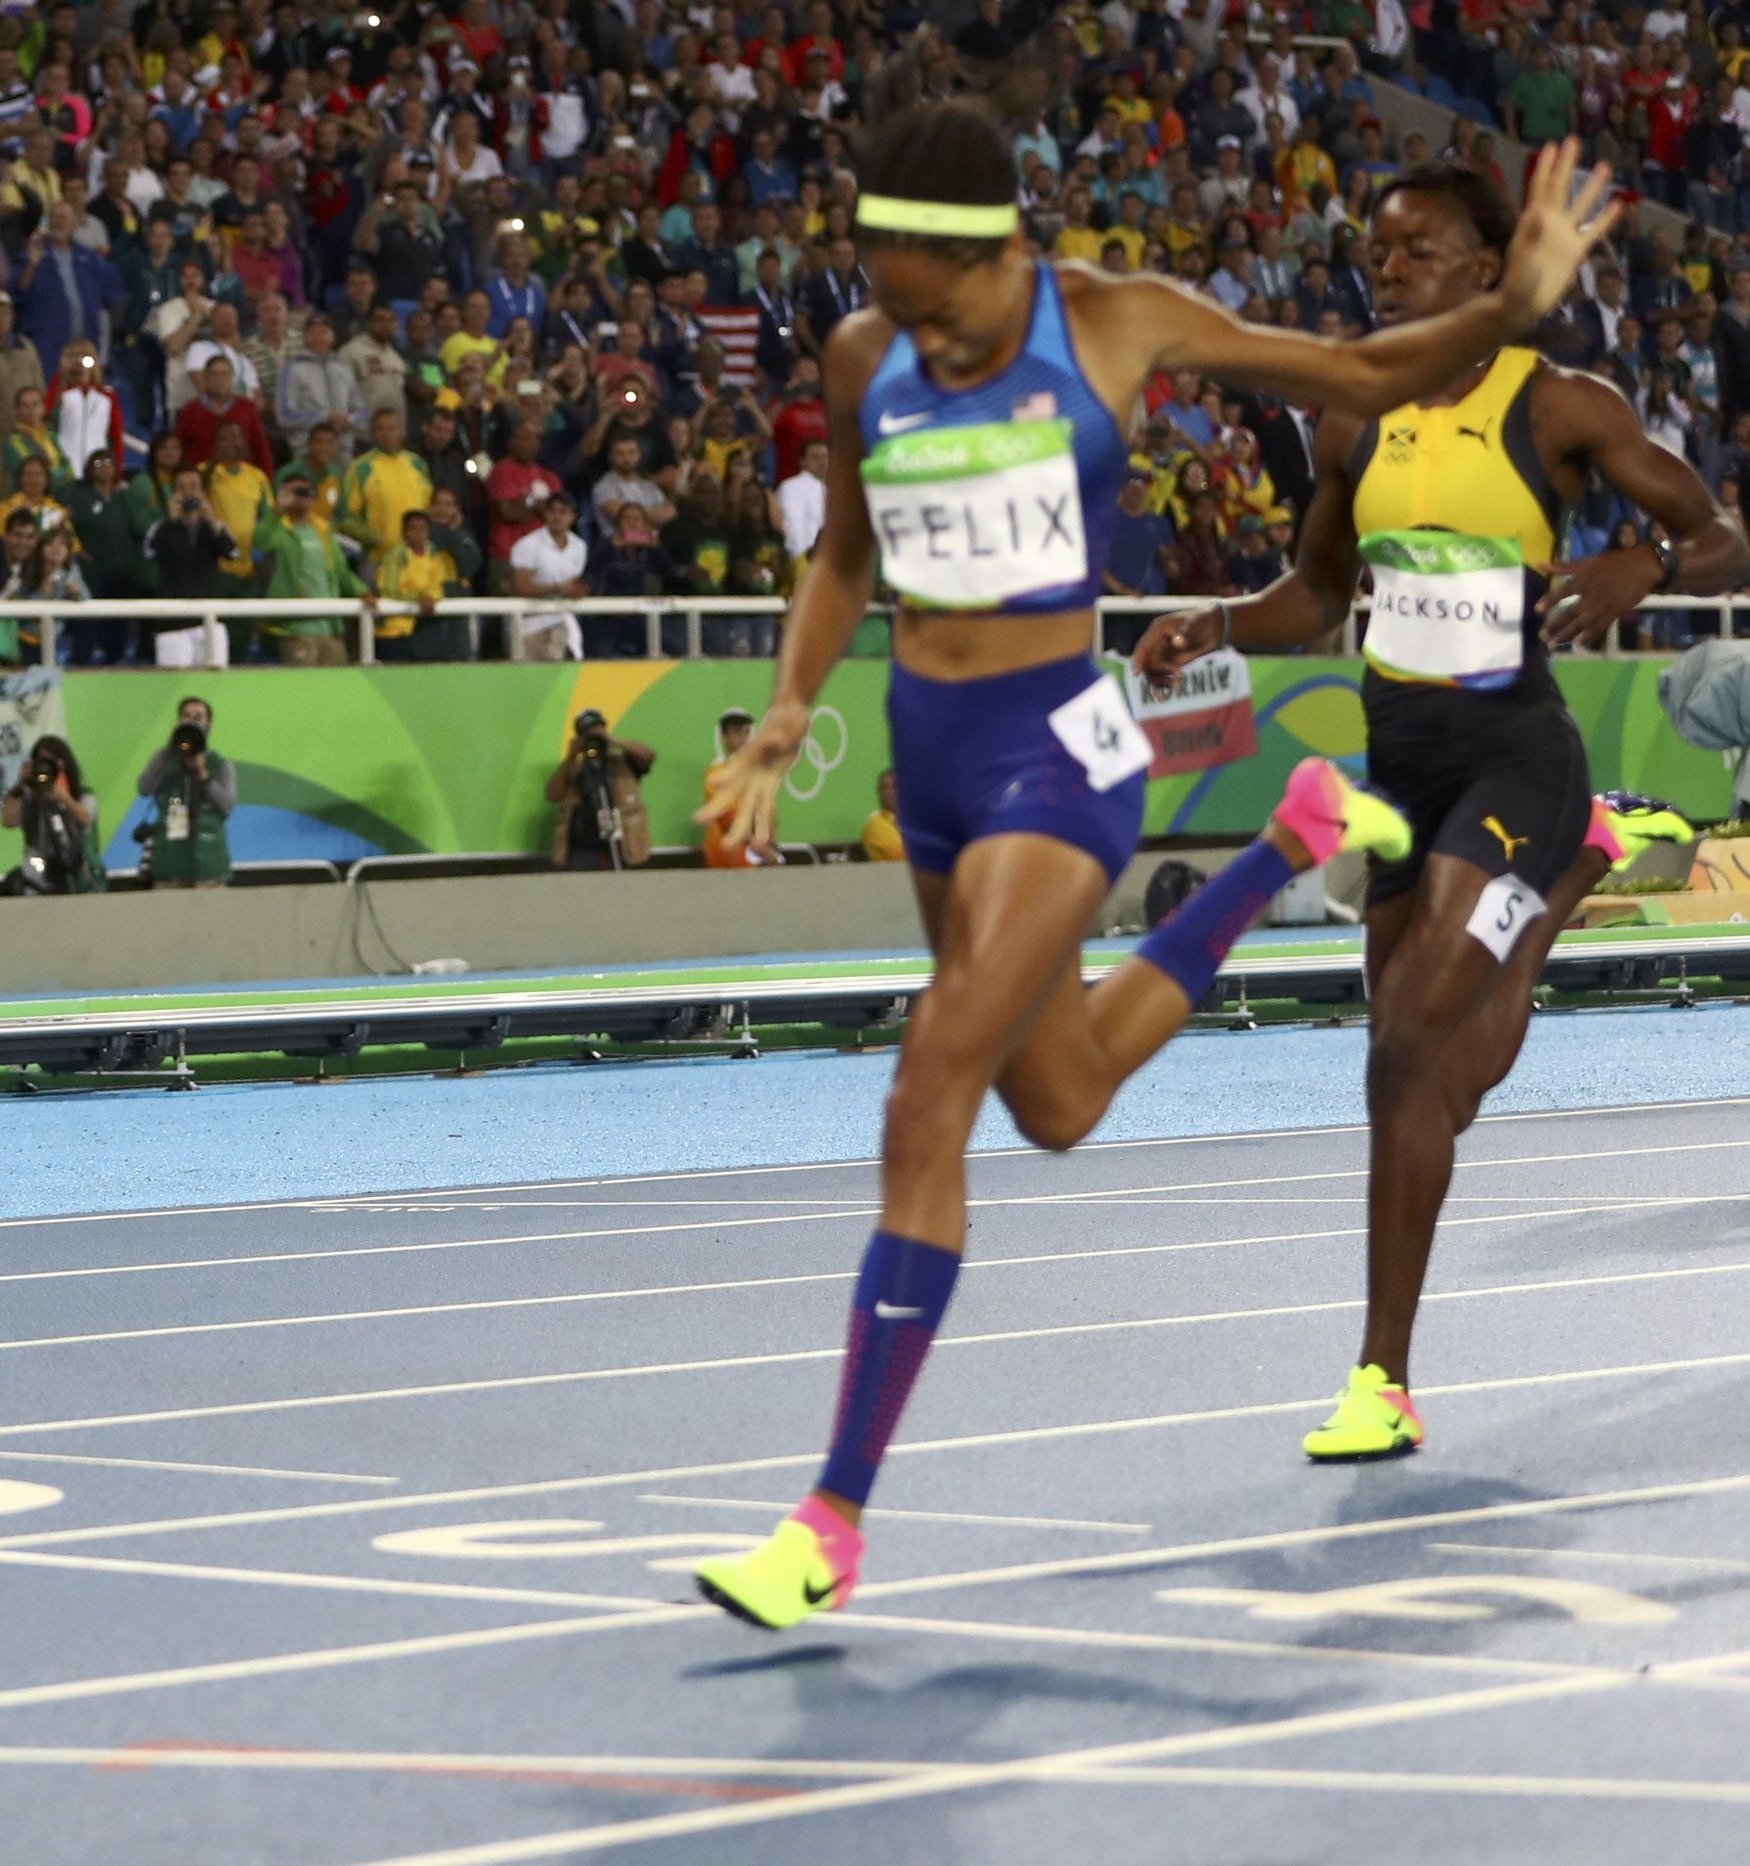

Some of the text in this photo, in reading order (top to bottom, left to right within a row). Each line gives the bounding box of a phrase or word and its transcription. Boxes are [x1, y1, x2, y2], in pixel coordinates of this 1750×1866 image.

[879, 493, 1074, 557] FELIX
[1376, 592, 1500, 622] JACKSON
[1093, 710, 1119, 751] 4
[370, 1518, 775, 1574] 5
[1154, 1573, 1679, 1625] 4
